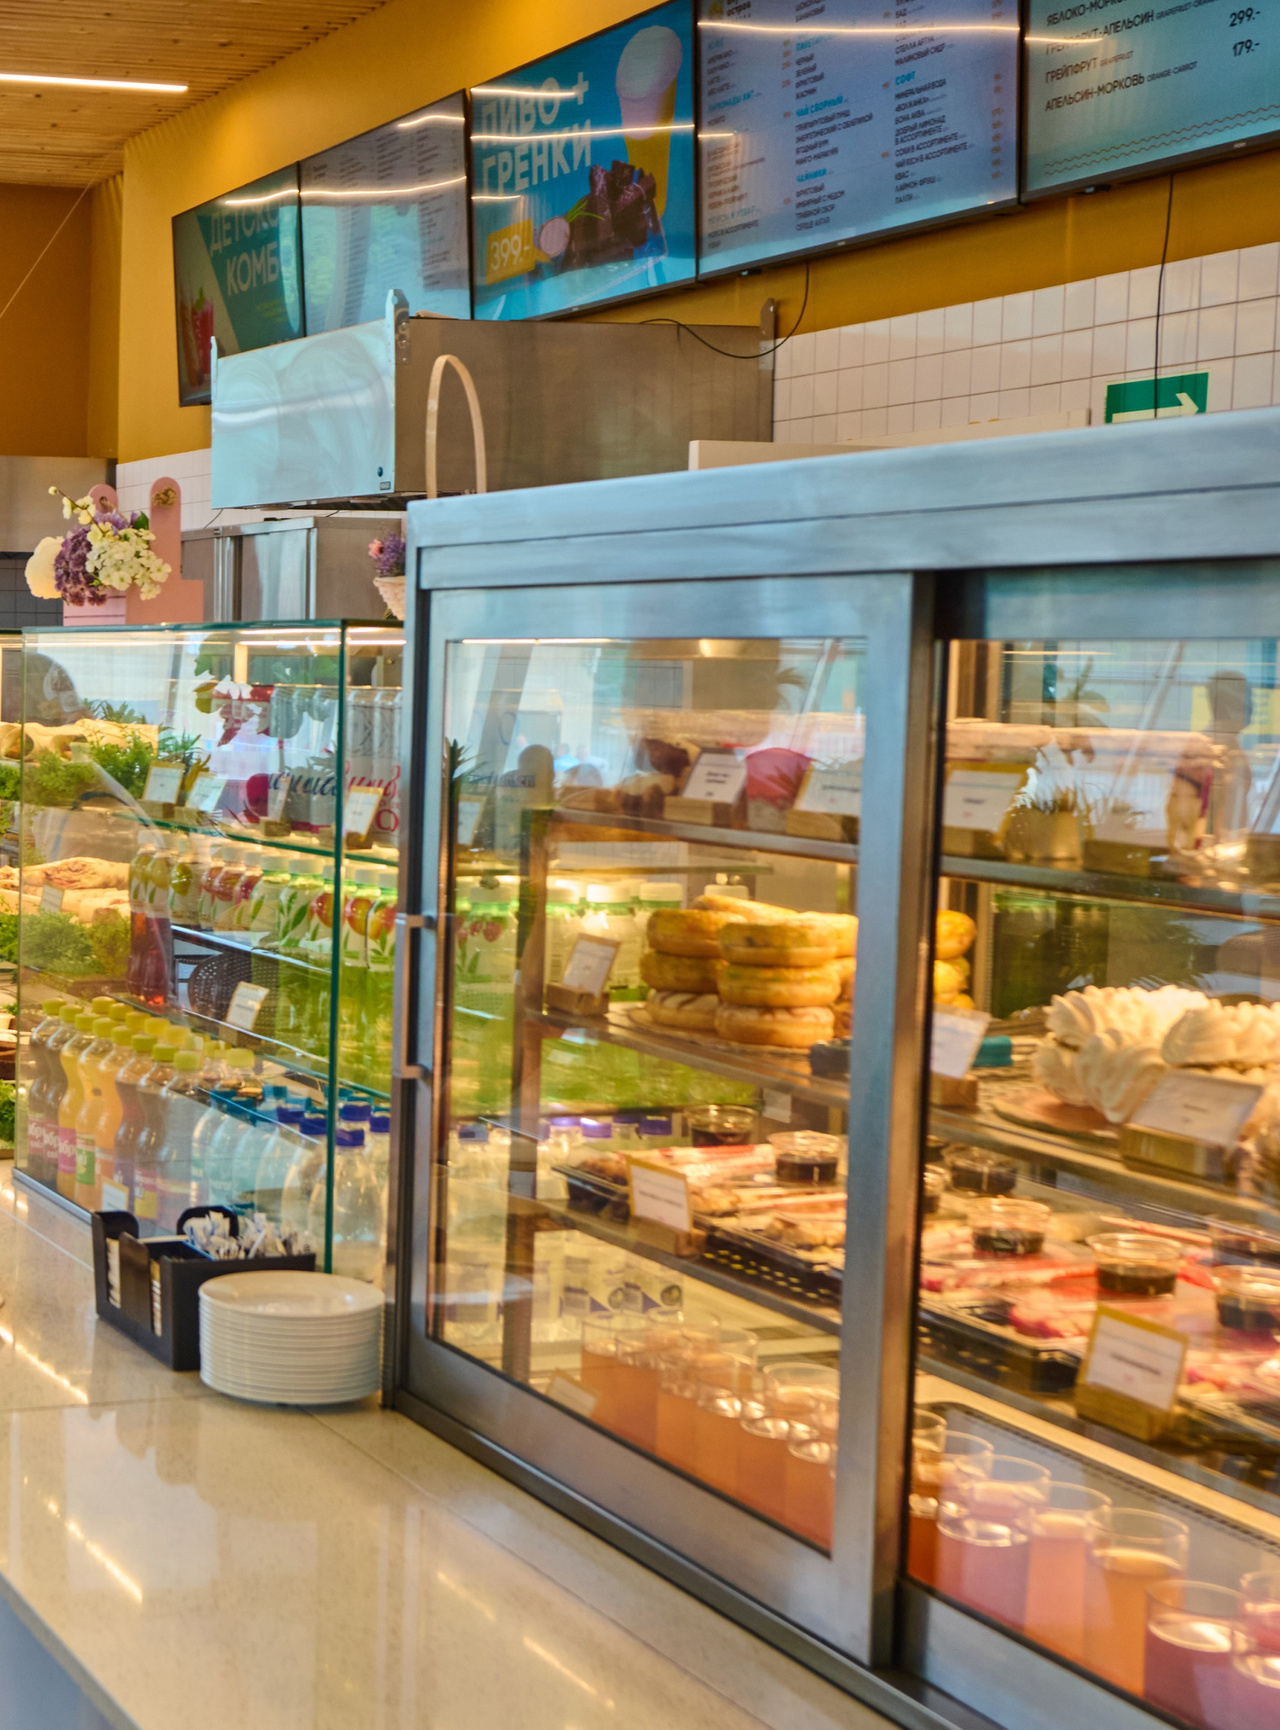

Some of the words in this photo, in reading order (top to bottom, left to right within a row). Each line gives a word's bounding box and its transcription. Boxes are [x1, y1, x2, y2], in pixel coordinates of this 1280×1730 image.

[1229, 7, 1261, 27] 299.-
[1232, 39, 1260, 57] 179.-
[1045, 57, 1098, 83] ГРЕЙПФРУТ
[1045, 73, 1145, 111] АПЕЛЬСИН-МОРКОВЬ
[482, 77, 560, 149] ПИВО
[483, 119, 591, 196] ГРЕНКИ
[226, 241, 280, 296] КОМБ
[490, 234, 530, 270] 399.-
